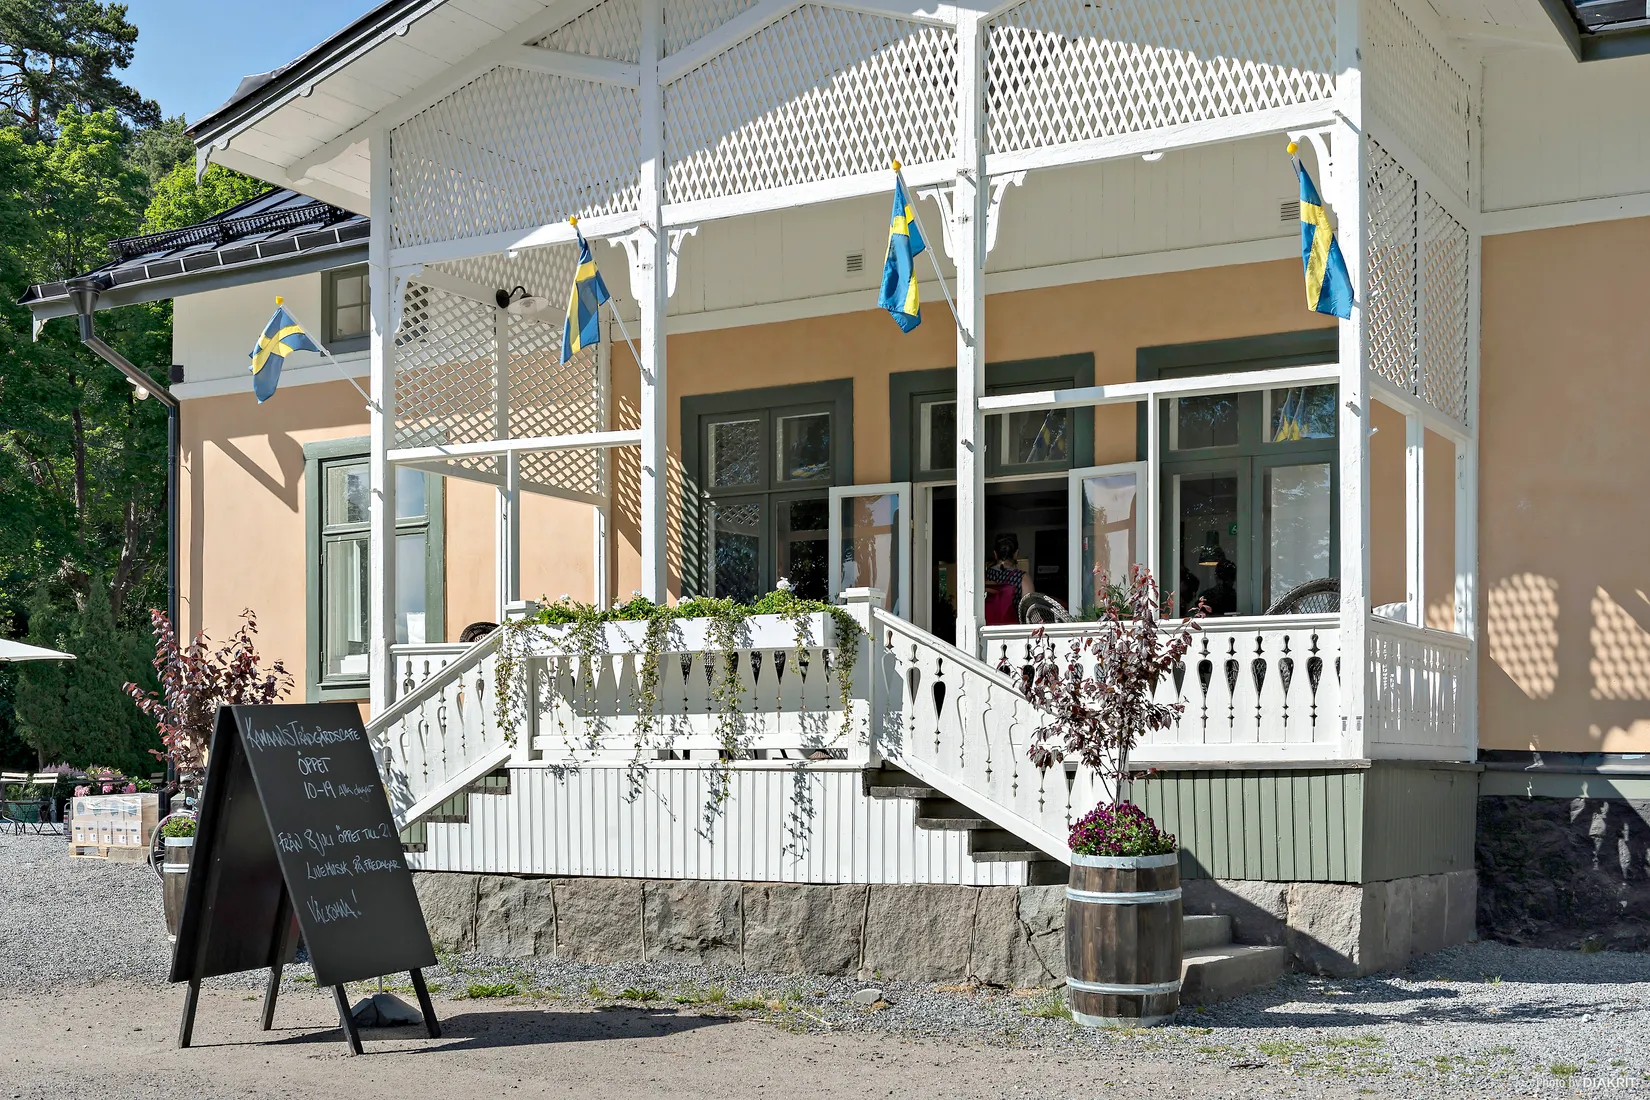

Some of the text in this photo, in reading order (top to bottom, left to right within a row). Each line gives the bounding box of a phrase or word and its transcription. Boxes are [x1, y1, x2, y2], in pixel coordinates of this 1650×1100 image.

[297, 751, 331, 775] ÖPPET
[303, 781, 336, 799] 10-19
[278, 823, 392, 857] FRÅN 8 JULI ÖPPET TILL 21
[353, 855, 367, 873] PÅ
[364, 858, 401, 873] FREDAGAR
